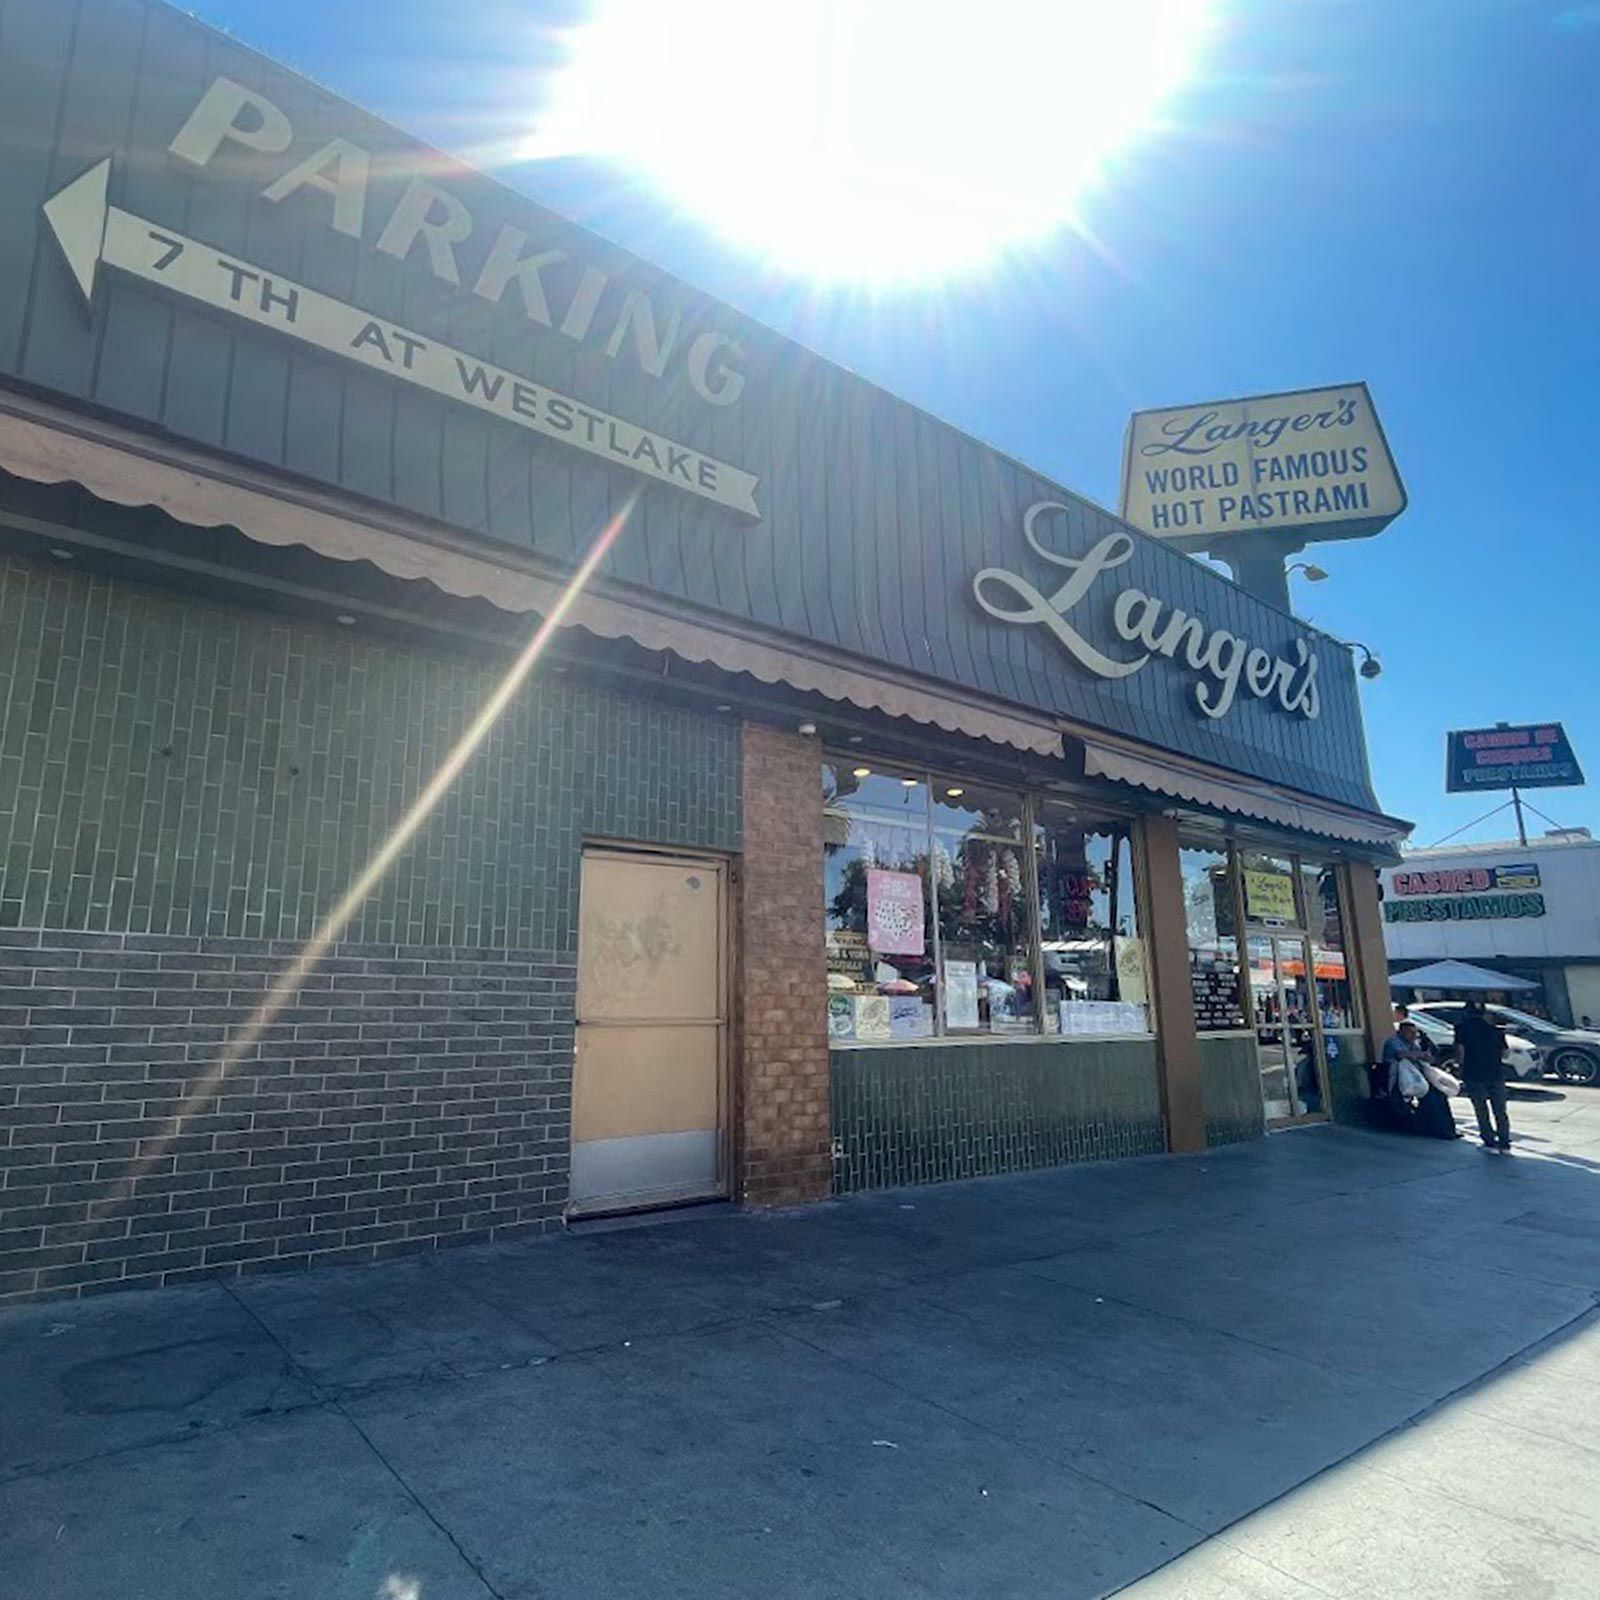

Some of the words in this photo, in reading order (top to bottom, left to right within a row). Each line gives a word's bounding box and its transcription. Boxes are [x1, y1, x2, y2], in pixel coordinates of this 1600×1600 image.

[168, 76, 748, 407] PARKING
[149, 231, 184, 271] 7
[217, 258, 299, 323] TH
[350, 321, 427, 371] AT
[455, 356, 718, 492] WESTLAKE
[1140, 398, 1357, 456] Langer's
[1145, 462, 1239, 495] WORLD
[1253, 447, 1369, 484] FAMOUS
[1152, 500, 1204, 529] HOT
[1219, 482, 1370, 523] PASTRAMI
[973, 500, 1321, 720] Langer's
[1384, 893, 1545, 922] PRESTAMOS
